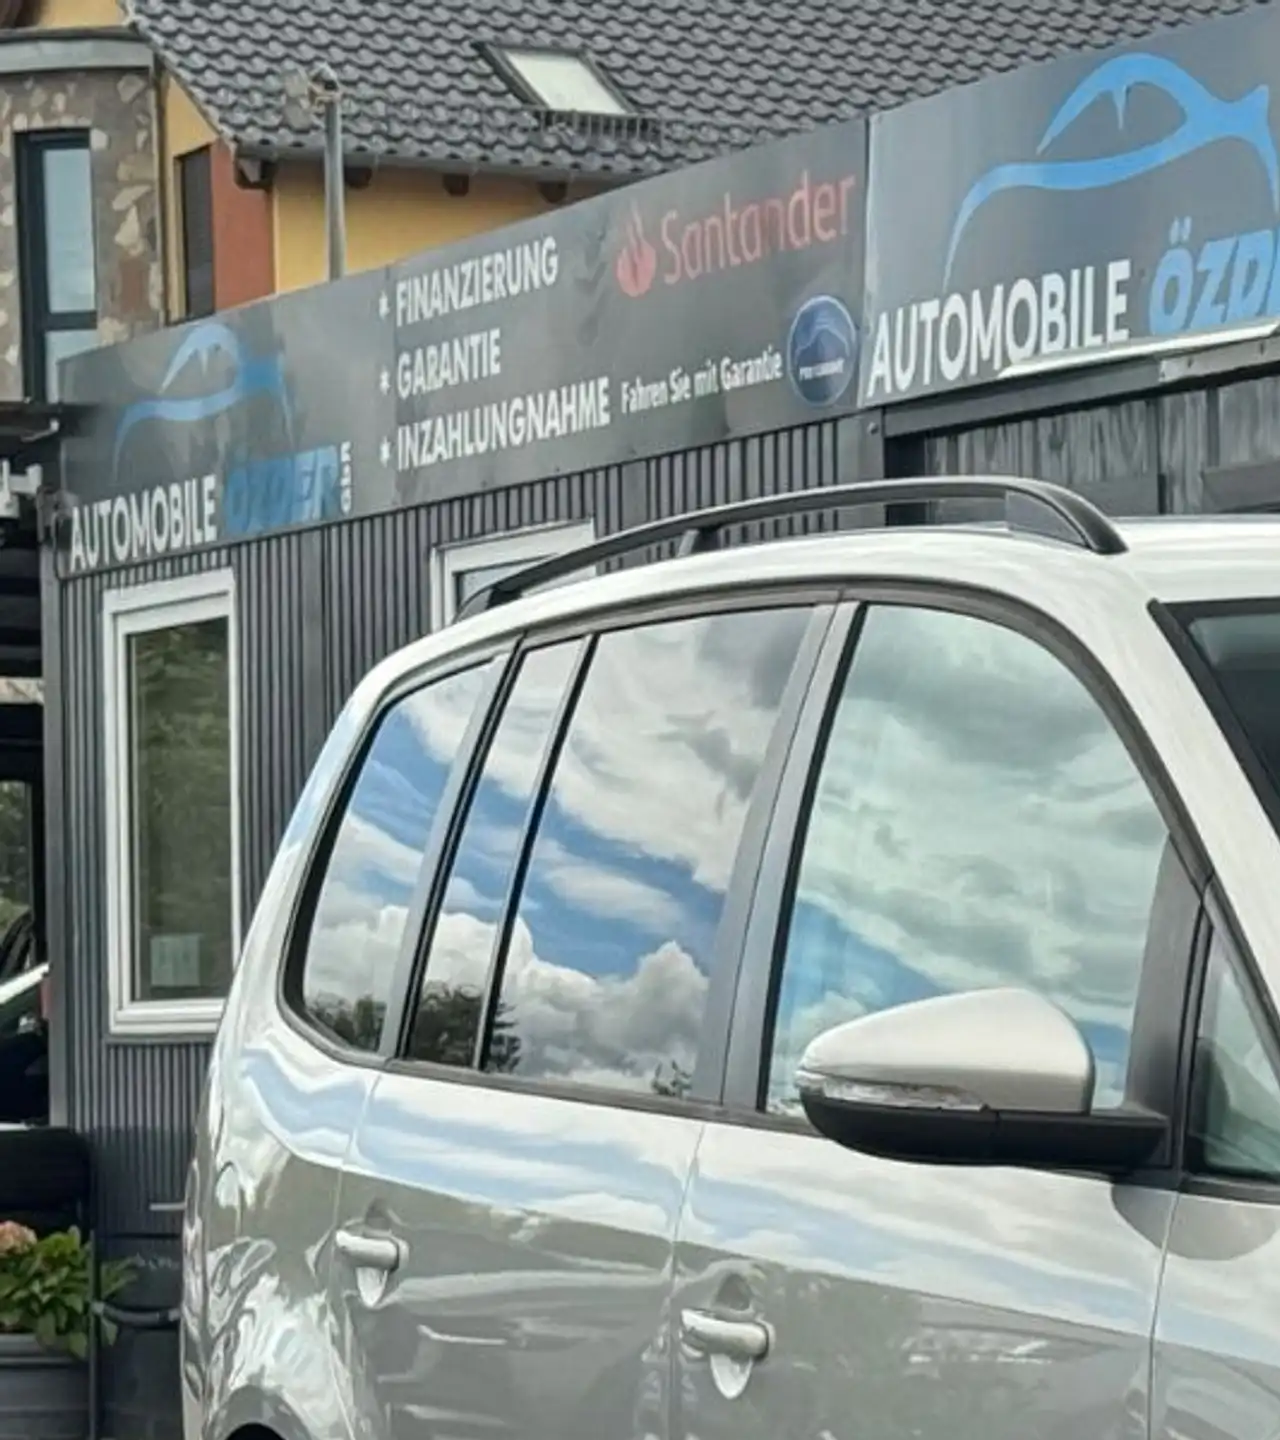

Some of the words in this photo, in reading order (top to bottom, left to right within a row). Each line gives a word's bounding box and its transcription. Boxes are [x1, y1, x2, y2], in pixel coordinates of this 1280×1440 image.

[661, 169, 856, 285] Santander
[396, 236, 559, 328] FINANZIERUNG
[867, 259, 1132, 398] AUTOMOBILE
[397, 327, 501, 399] GARANTIE
[621, 376, 669, 414] Fahren
[669, 366, 692, 404] Sie
[693, 358, 720, 397] mit
[720, 344, 783, 391] Garantie
[398, 376, 611, 471] INZAHLUNGNAHME
[69, 474, 218, 572] AUTOMOBILE
